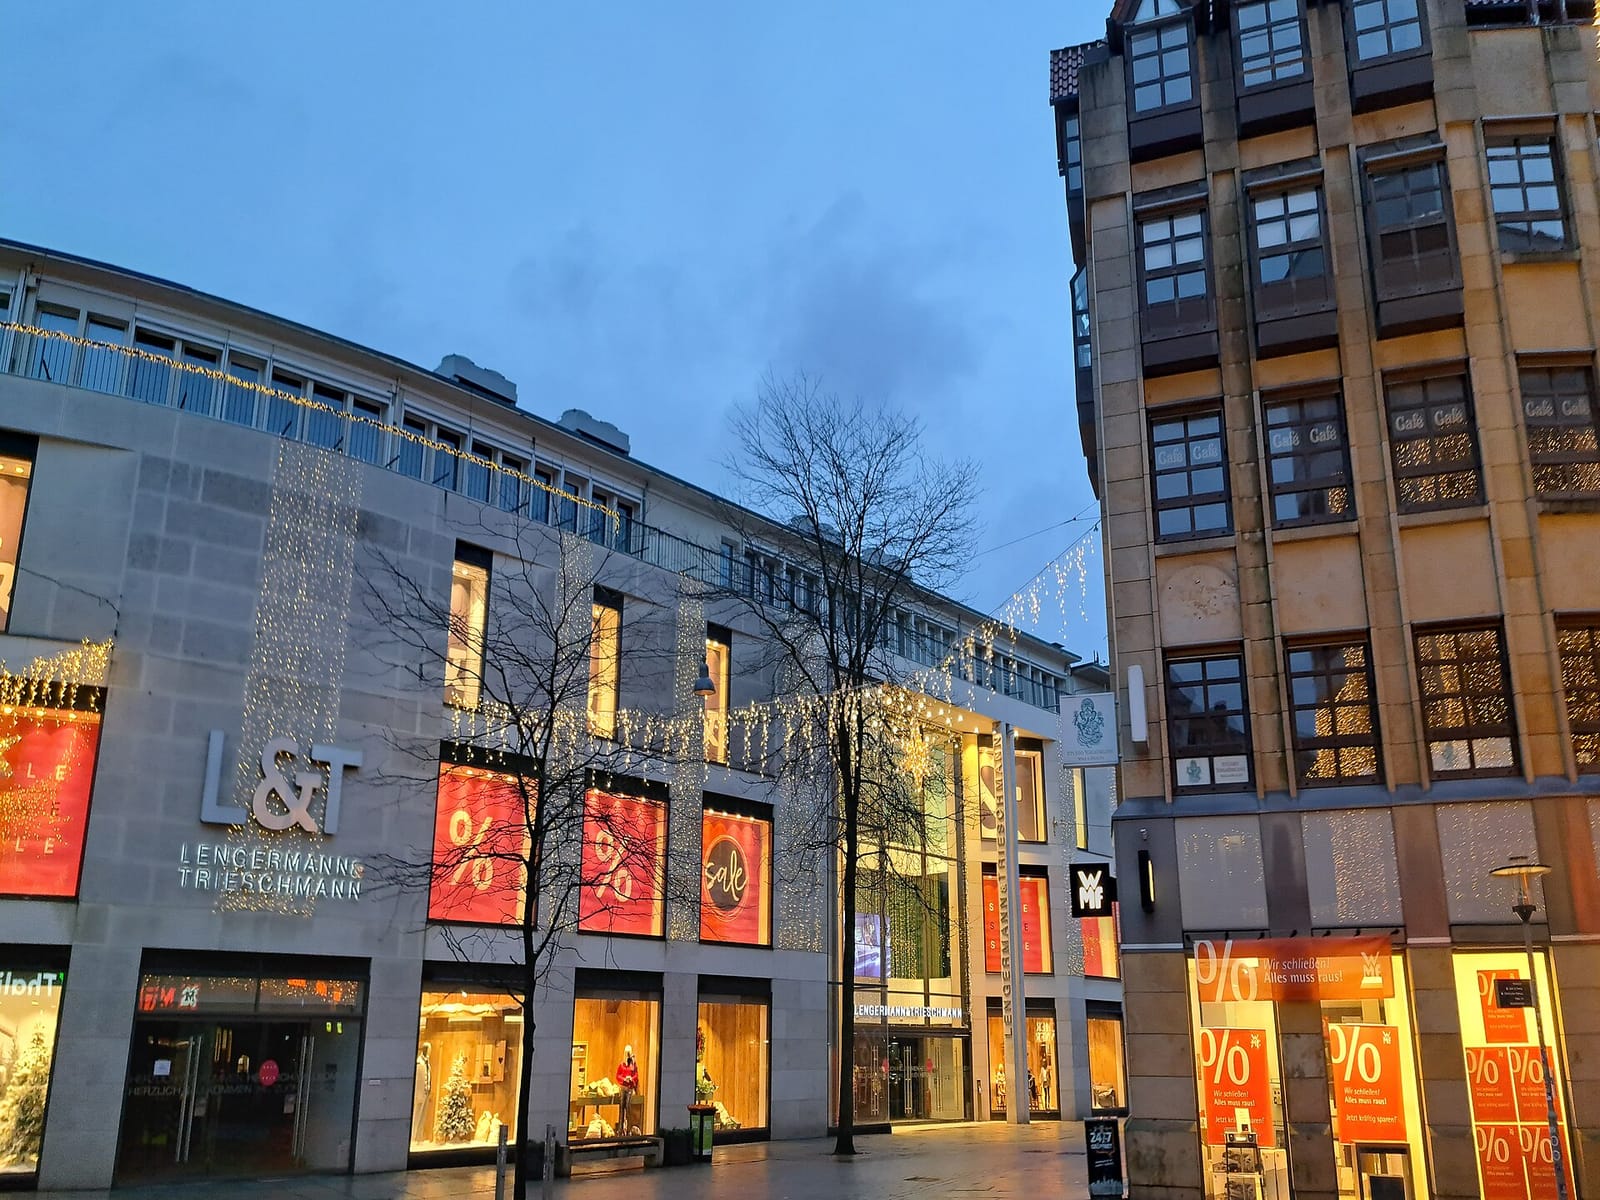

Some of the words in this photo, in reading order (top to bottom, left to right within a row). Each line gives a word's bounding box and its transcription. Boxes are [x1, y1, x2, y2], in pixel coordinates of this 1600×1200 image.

[1310, 424, 1337, 444] Café
[200, 730, 363, 835] L&T
[178, 867, 362, 901] TRIESCHMANN
[704, 850, 748, 902] sale
[1263, 957, 1280, 970] Wir
[1282, 956, 1331, 971] schließen!
[1263, 971, 1288, 984] Alles
[1290, 974, 1315, 983] muss
[1318, 970, 1344, 983] raus!
